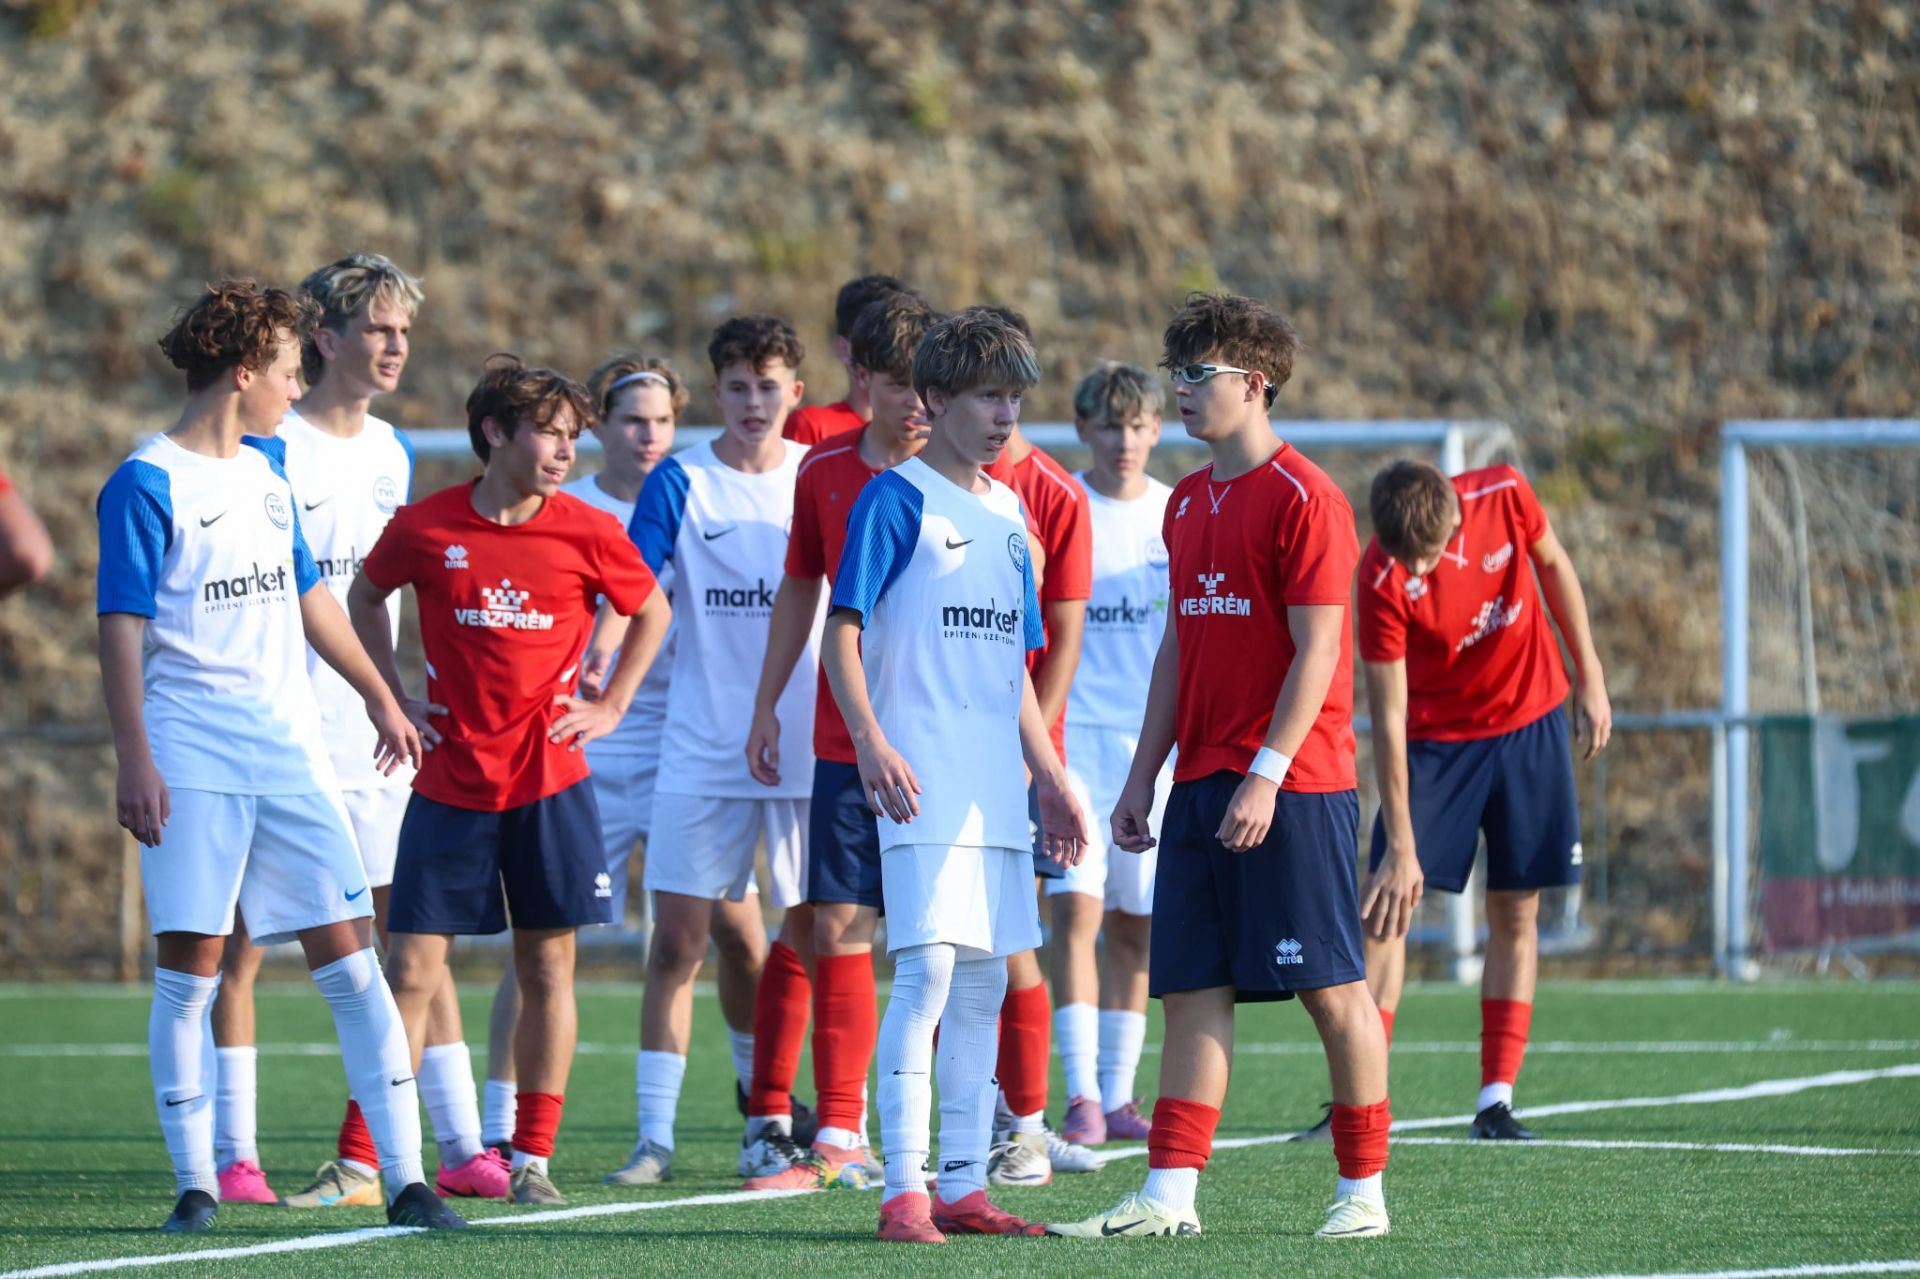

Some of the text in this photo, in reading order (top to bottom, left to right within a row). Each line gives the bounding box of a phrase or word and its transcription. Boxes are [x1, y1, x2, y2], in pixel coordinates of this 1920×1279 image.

[204, 561, 286, 602] market
[705, 577, 774, 607] mark
[454, 608, 554, 630] VESZPRÉM
[942, 597, 1018, 635] market
